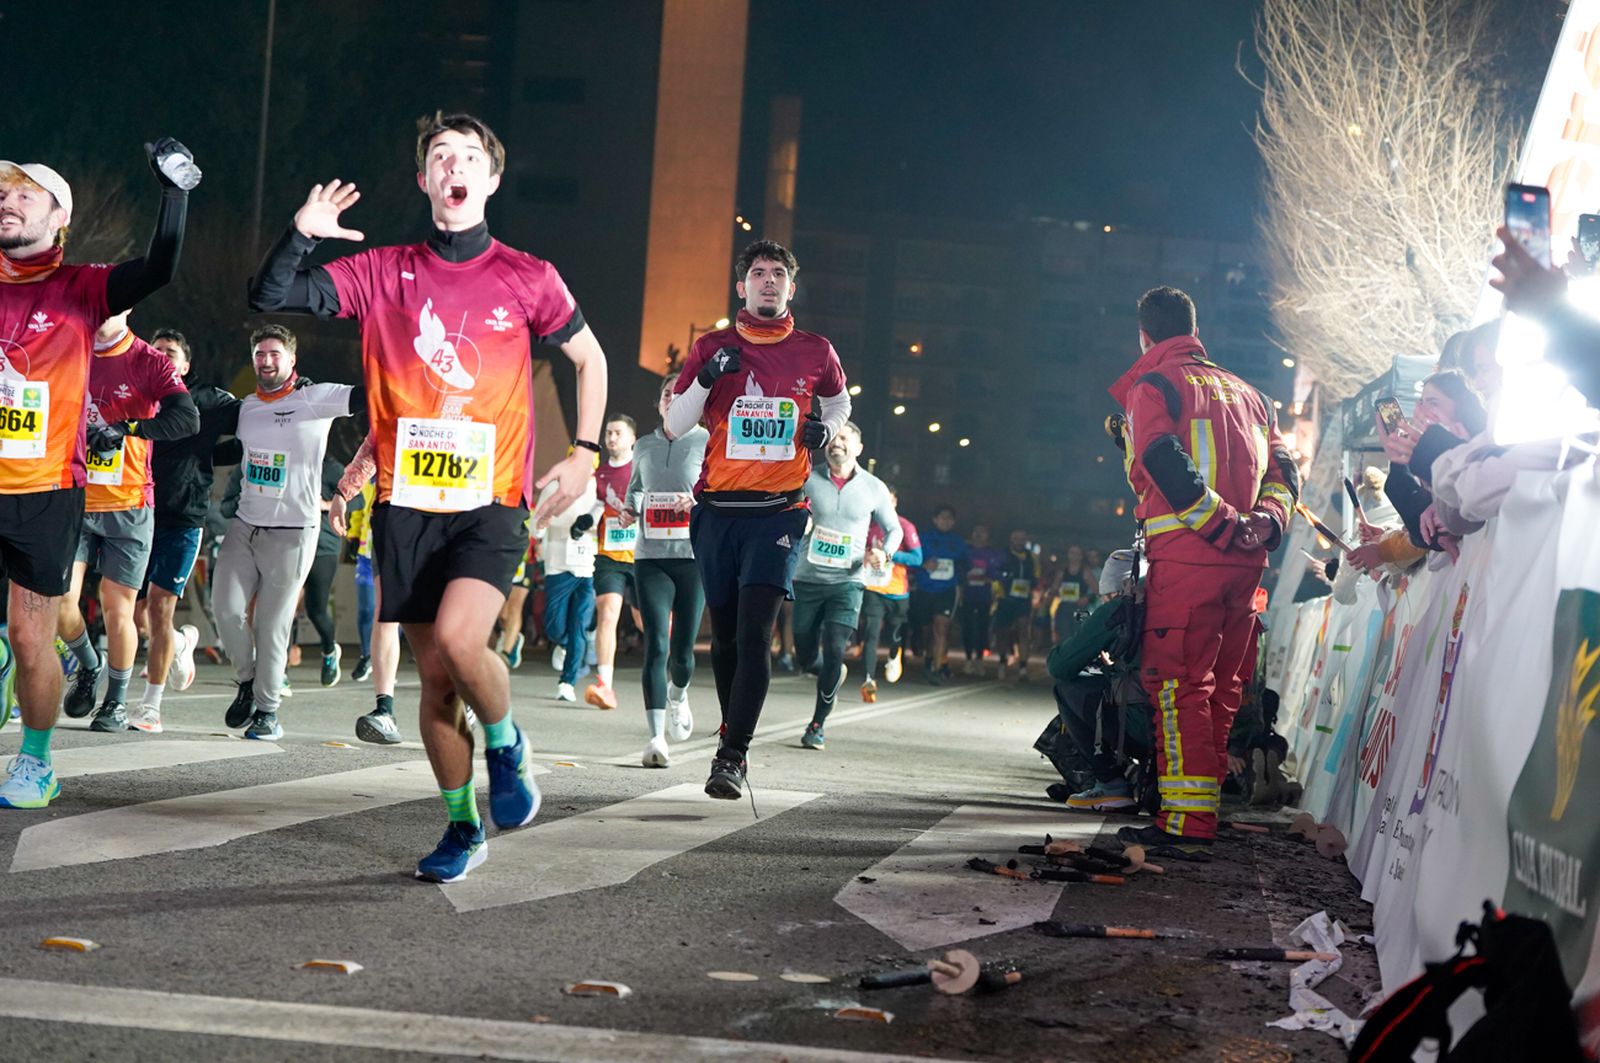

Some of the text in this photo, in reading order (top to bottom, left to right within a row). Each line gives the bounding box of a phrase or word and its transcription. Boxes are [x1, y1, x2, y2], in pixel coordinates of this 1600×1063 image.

[431, 349, 454, 373] 43
[418, 429, 445, 439] NOCHE
[742, 418, 786, 438] 9007
[408, 439, 424, 448] SAN
[411, 452, 478, 479] 12782
[817, 540, 845, 556] 2206
[1539, 842, 1587, 918] RURAL
